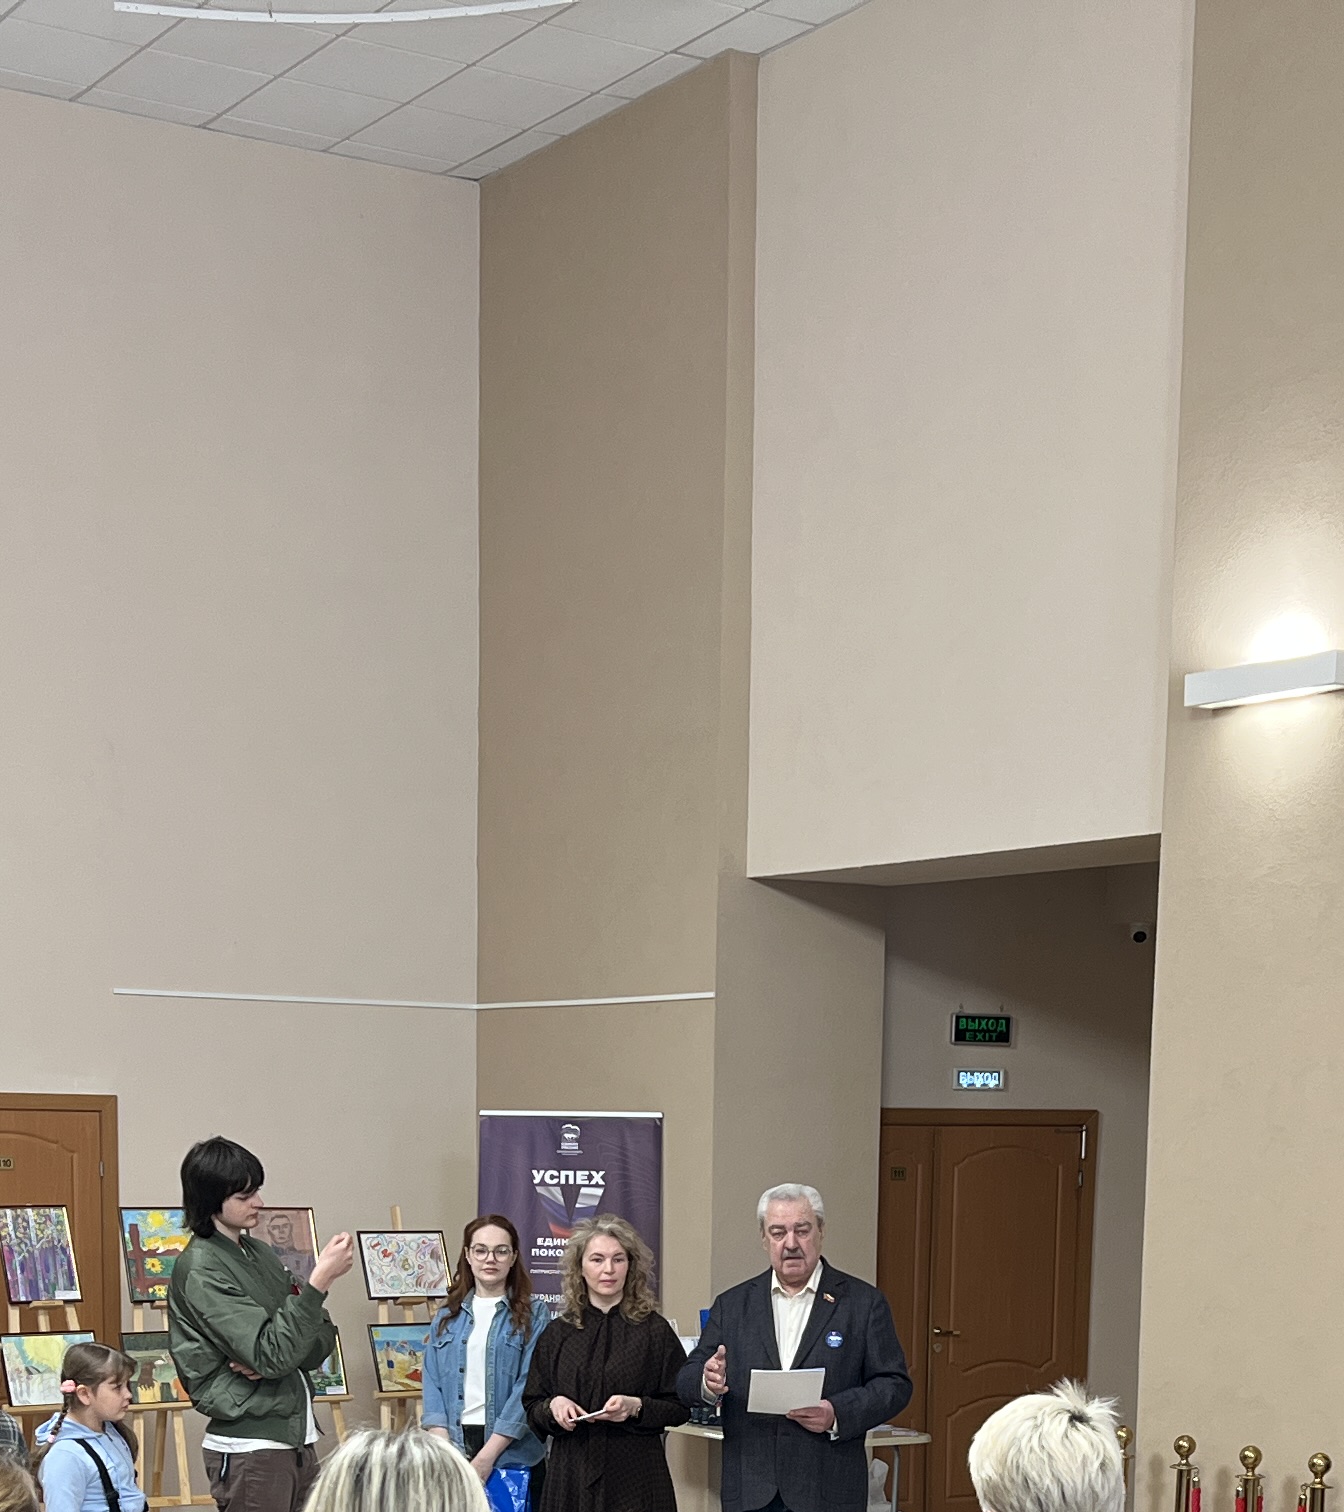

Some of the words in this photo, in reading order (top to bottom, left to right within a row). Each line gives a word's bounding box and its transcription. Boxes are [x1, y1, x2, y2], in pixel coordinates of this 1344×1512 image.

[959, 1018, 1007, 1033] ВЫХОД
[965, 1032, 998, 1041] EXIT
[959, 1072, 999, 1087] ВЫХОД
[531, 1169, 606, 1186] УСПЕХ
